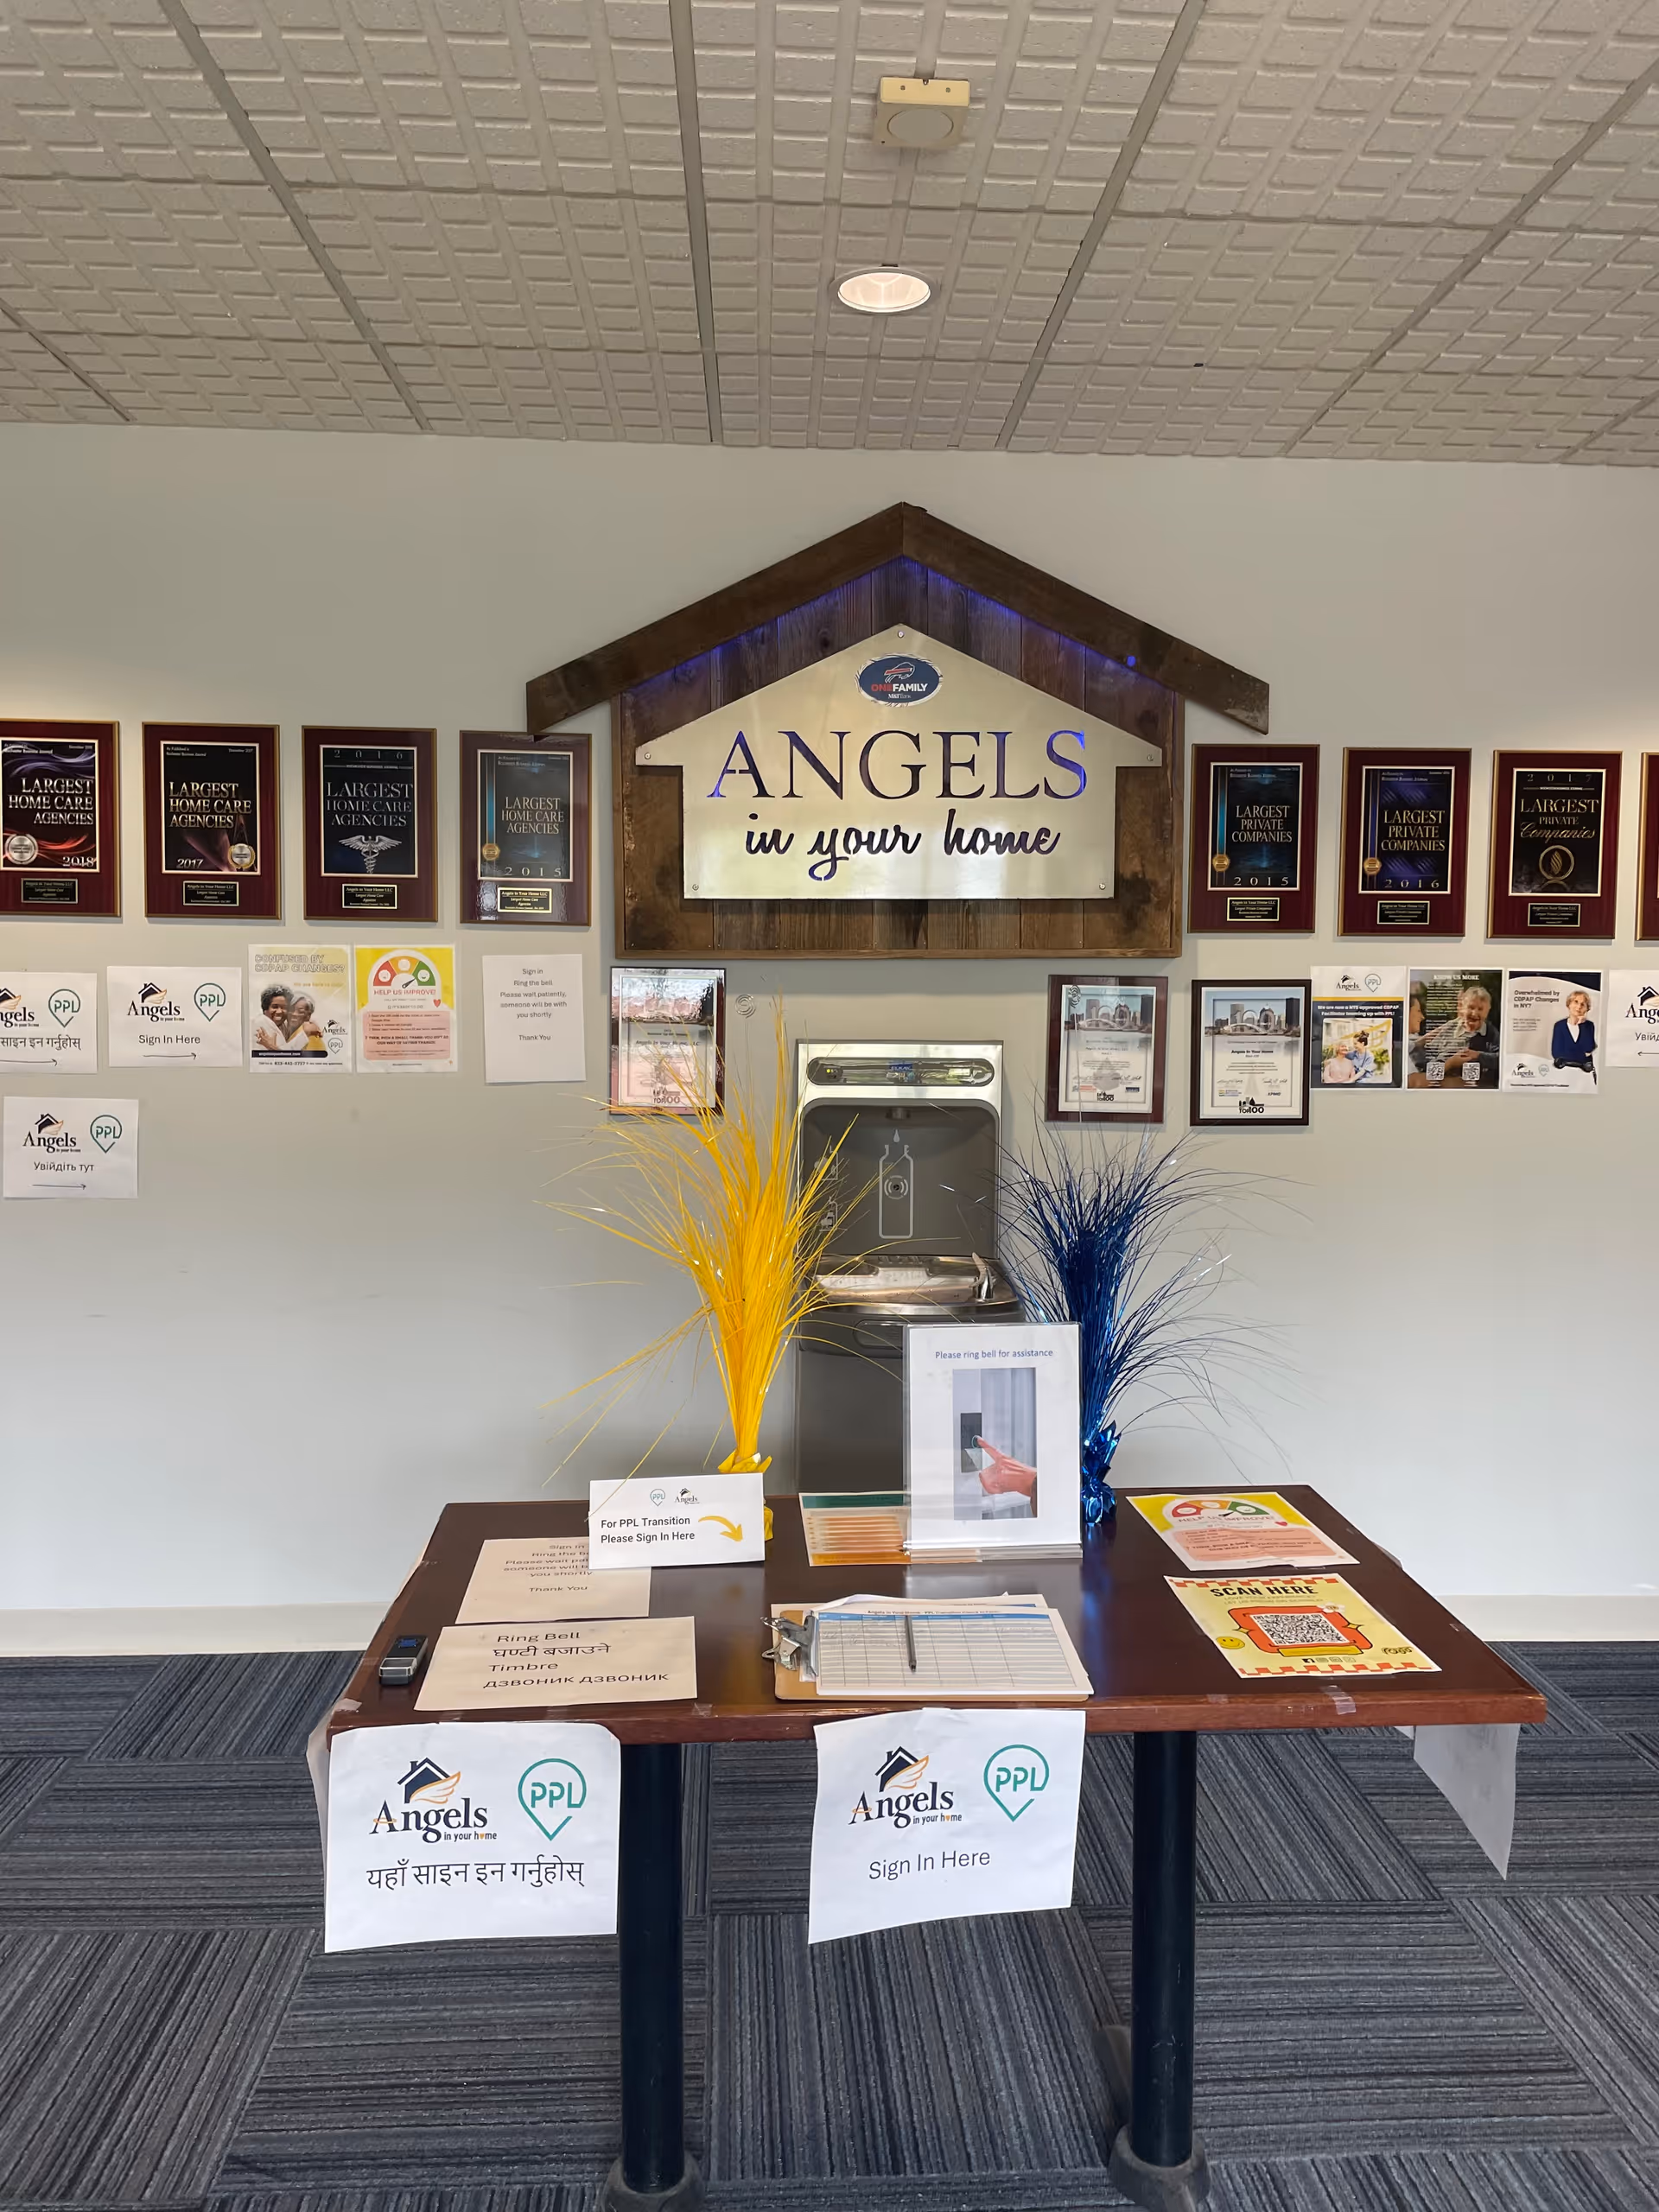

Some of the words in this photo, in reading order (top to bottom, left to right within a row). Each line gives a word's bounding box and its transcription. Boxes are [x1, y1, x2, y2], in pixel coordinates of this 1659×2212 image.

[334, 749, 403, 760] 2016
[707, 730, 1087, 800] ANGELS
[1527, 773, 1592, 782] 2017
[22, 778, 93, 794] LARGEST
[169, 782, 238, 798] LARGEST
[327, 782, 413, 798] LARGEST
[8, 795, 51, 809] HOME
[54, 796, 93, 810] CARE
[169, 798, 210, 813] HOME
[213, 799, 251, 814] CARE
[327, 800, 371, 812] HOME
[372, 800, 412, 813] CARE
[505, 797, 561, 810] LARGEST
[1521, 798, 1599, 813] LARGEST
[501, 810, 532, 821] HOME
[535, 811, 564, 823] CARE
[1236, 804, 1289, 818] LARGEST
[1383, 810, 1446, 824] LARGEST
[34, 812, 93, 824] AGENCIES
[169, 815, 234, 829] AGENCIES
[331, 814, 407, 827] AGENCIES
[1241, 819, 1284, 830] PRIVATE
[1539, 816, 1579, 825] PRIVATE
[507, 823, 559, 834] AGENCIES
[1389, 825, 1440, 838] PRIVATE
[1521, 823, 1596, 843] Companies
[1231, 831, 1293, 842] COMPANIES
[747, 813, 794, 855] in
[807, 824, 921, 881] your
[944, 809, 1061, 855] home
[1381, 839, 1446, 851] COMPANIES
[62, 855, 94, 868] 2018
[176, 858, 204, 869] 2017
[505, 867, 562, 878] 2015
[1233, 876, 1288, 887] 2015
[1384, 879, 1440, 888] 2016
[255, 954, 308, 963] CONFUSED
[311, 954, 324, 963] BY
[255, 963, 289, 972] CDPAP
[291, 963, 346, 973] CHANGES?
[54, 1000, 79, 1013] PPL
[200, 995, 225, 1007] PPL
[127, 1001, 181, 1022] Angels
[29, 1038, 43, 1048] इन
[139, 1035, 161, 1045] Sign
[163, 1035, 173, 1044] In
[175, 1035, 200, 1044] Here
[96, 1126, 119, 1139] PPL
[22, 1131, 77, 1153] Angels
[34, 1161, 76, 1171] Увійдіть
[79, 1163, 94, 1173] тут
[935, 1351, 962, 1359] Please
[963, 1351, 979, 1361] ring
[982, 1350, 996, 1358] bell
[1012, 1349, 1053, 1357] assistance
[675, 1495, 698, 1504] Angels
[601, 1519, 617, 1529] For
[620, 1518, 639, 1528] PPL
[641, 1516, 690, 1527] Transition
[601, 1534, 633, 1543] Please
[636, 1533, 658, 1544] Sign
[660, 1532, 670, 1541] In
[672, 1531, 695, 1541] Here
[1210, 1587, 1263, 1597] SCAN
[1266, 1586, 1318, 1595] HERE
[497, 1635, 539, 1643] Ring
[543, 1631, 581, 1641] Bell
[493, 1645, 538, 1658] घण्टी
[543, 1643, 612, 1656] बजाउने
[489, 1662, 558, 1672] Timbre
[995, 1766, 1044, 1792] PPL
[531, 1782, 582, 1808] PPL
[849, 1782, 954, 1828] Angels
[369, 1798, 487, 1843] Angels
[921, 1815, 938, 1826] your
[444, 1831, 452, 1841] in
[454, 1832, 472, 1842] your
[868, 1859, 911, 1880] Sign
[918, 1854, 935, 1872] In
[942, 1850, 990, 1868] Here
[366, 1859, 409, 1891] यहाँ
[411, 1863, 470, 1885] साइन
[474, 1861, 506, 1885] इन
[510, 1854, 585, 1887] गर्नुहोस्
